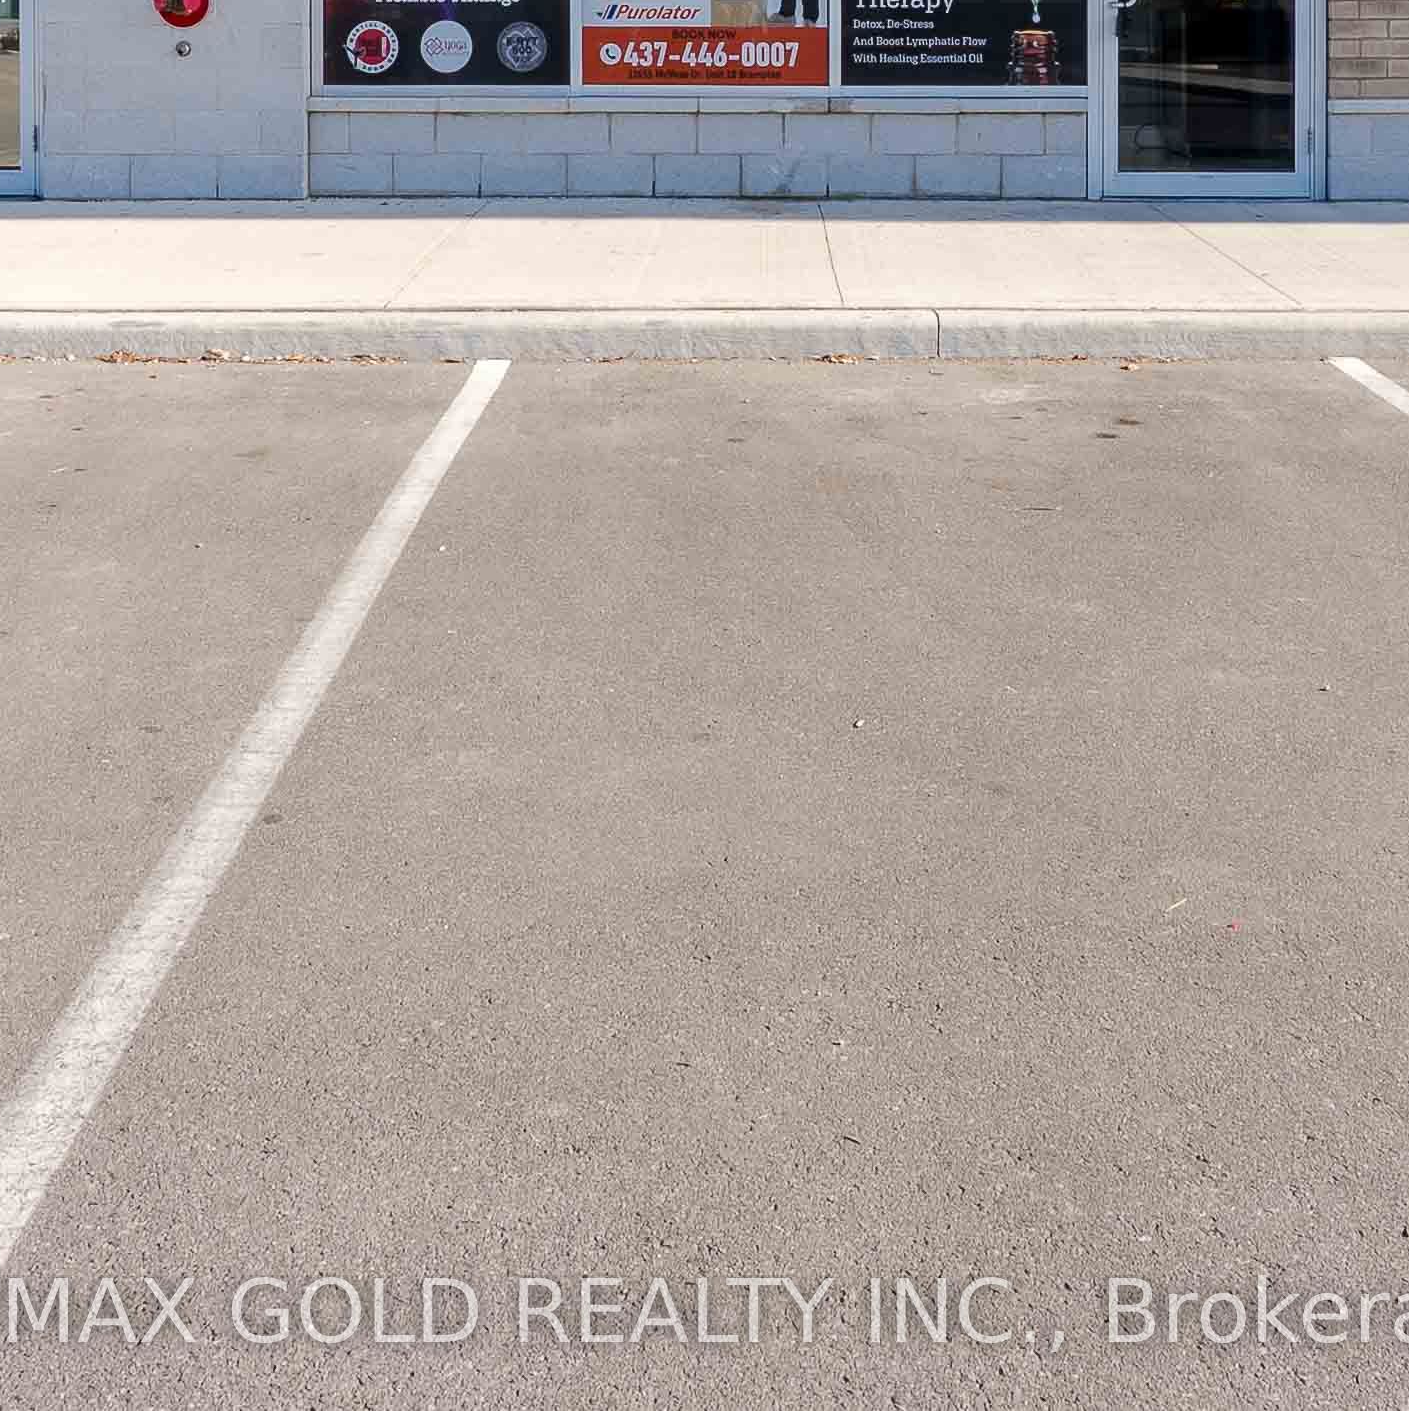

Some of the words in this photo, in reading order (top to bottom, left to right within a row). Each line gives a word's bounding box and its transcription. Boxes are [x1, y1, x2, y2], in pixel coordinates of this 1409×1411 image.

[615, 4, 701, 20] Purolator
[853, 19, 885, 30] Detox,
[887, 19, 934, 29] De-Stress
[672, 29, 704, 39] BOOK
[707, 29, 737, 39] NOW
[853, 36, 874, 46] And
[876, 36, 905, 46] Boost
[907, 36, 960, 48] Lymphatic
[962, 36, 987, 46] Flow
[623, 42, 800, 68] 437-446-0007
[853, 54, 878, 64] With
[879, 54, 919, 65] Healing
[920, 54, 967, 64] Essential
[968, 54, 984, 64] Oil
